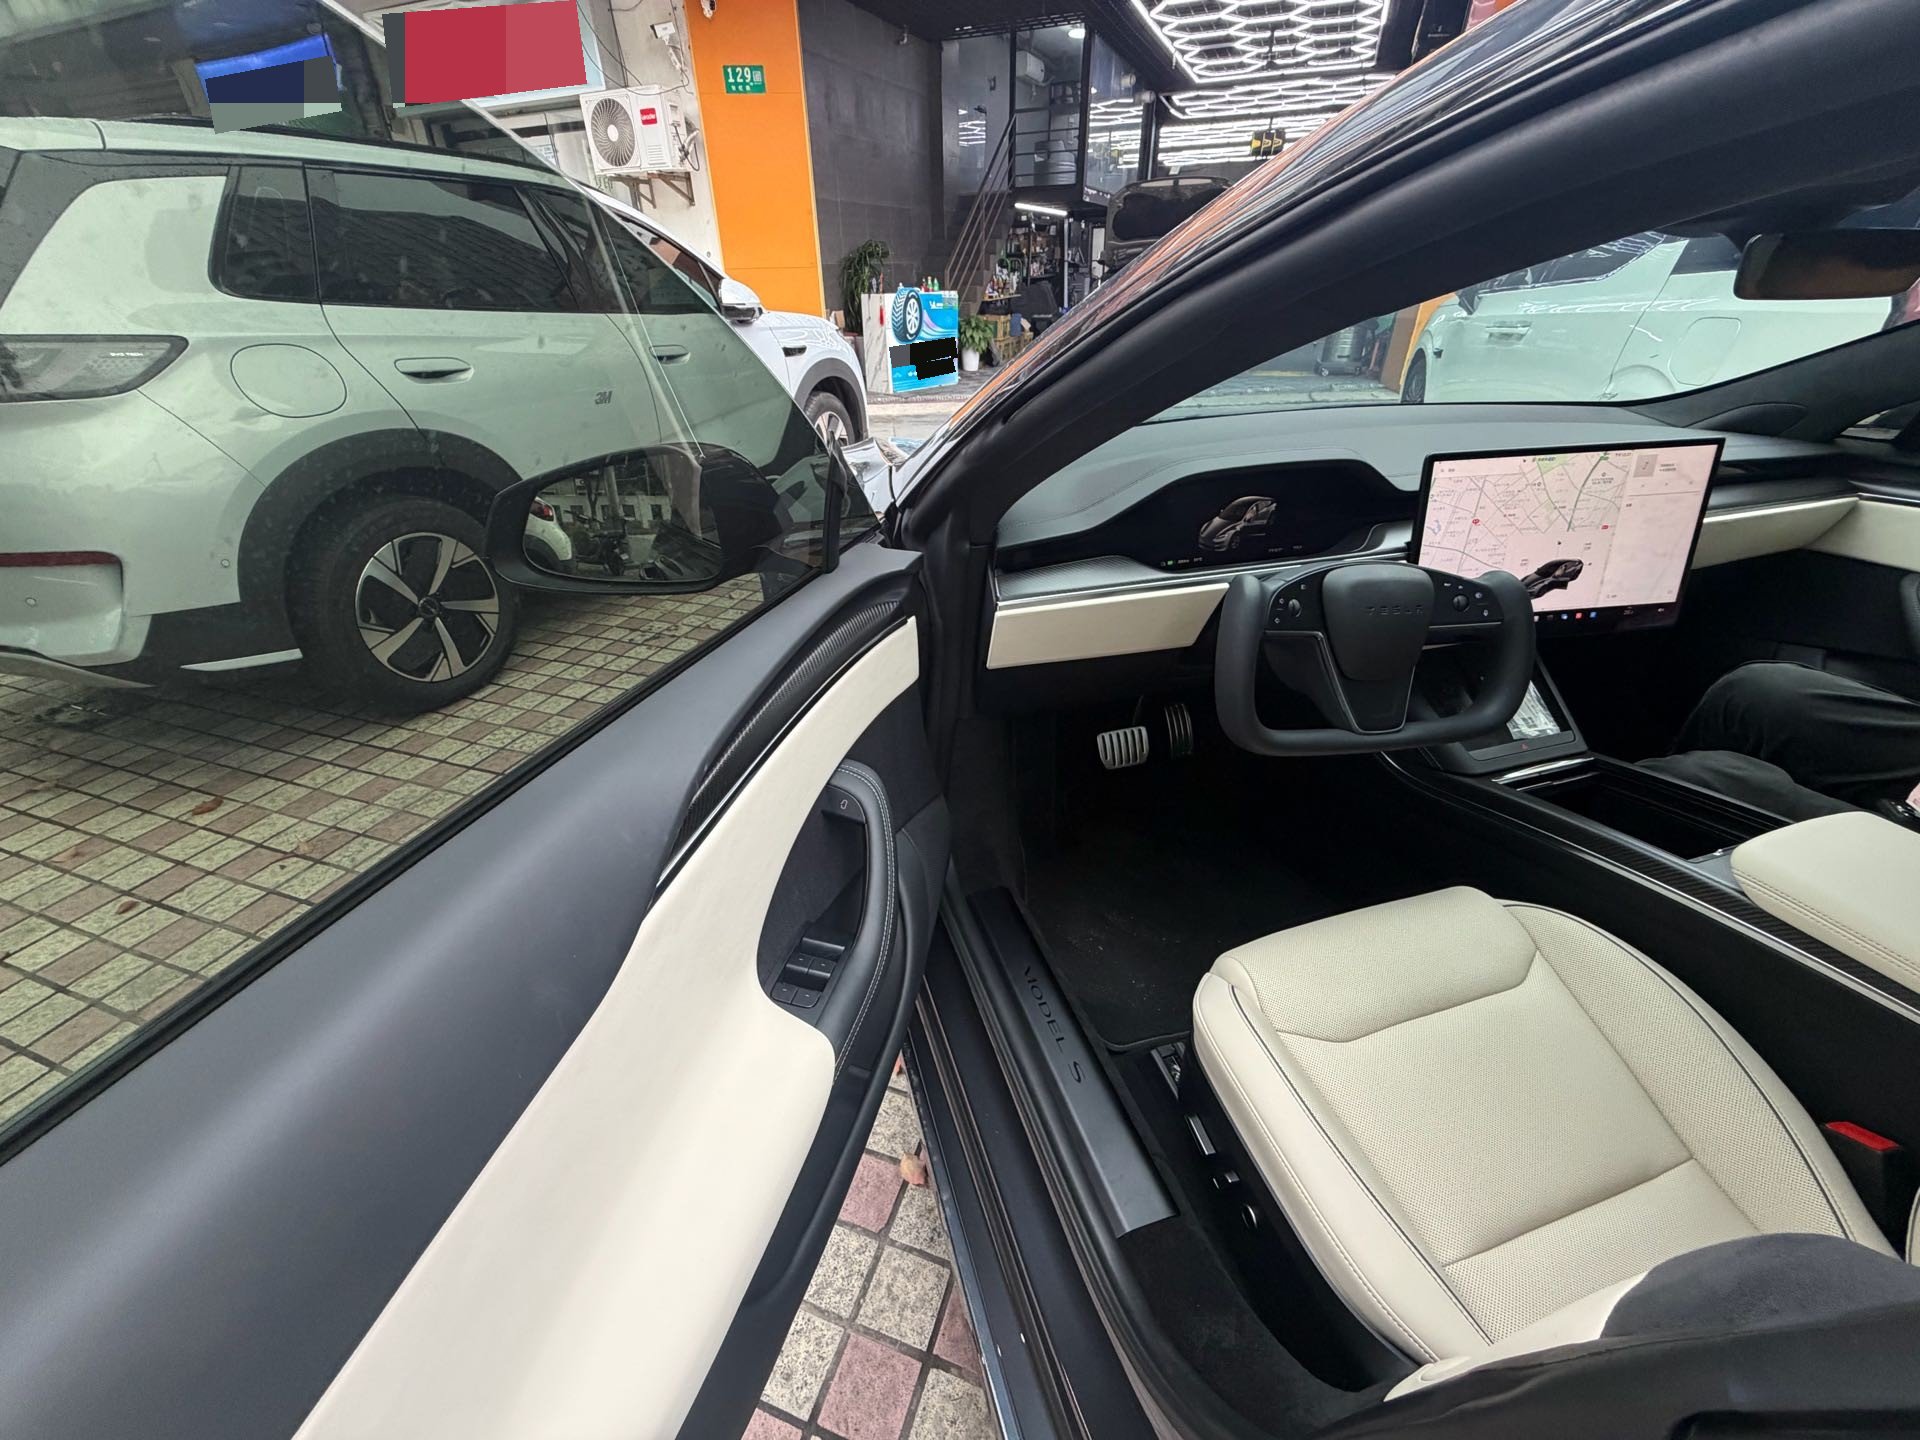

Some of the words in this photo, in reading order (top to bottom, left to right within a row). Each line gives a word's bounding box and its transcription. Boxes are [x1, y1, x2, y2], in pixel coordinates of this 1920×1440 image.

[727, 66, 751, 83] 129
[595, 390, 613, 405] 3M
[1024, 965, 1065, 1054] MODEL
[1068, 1060, 1086, 1084] S
